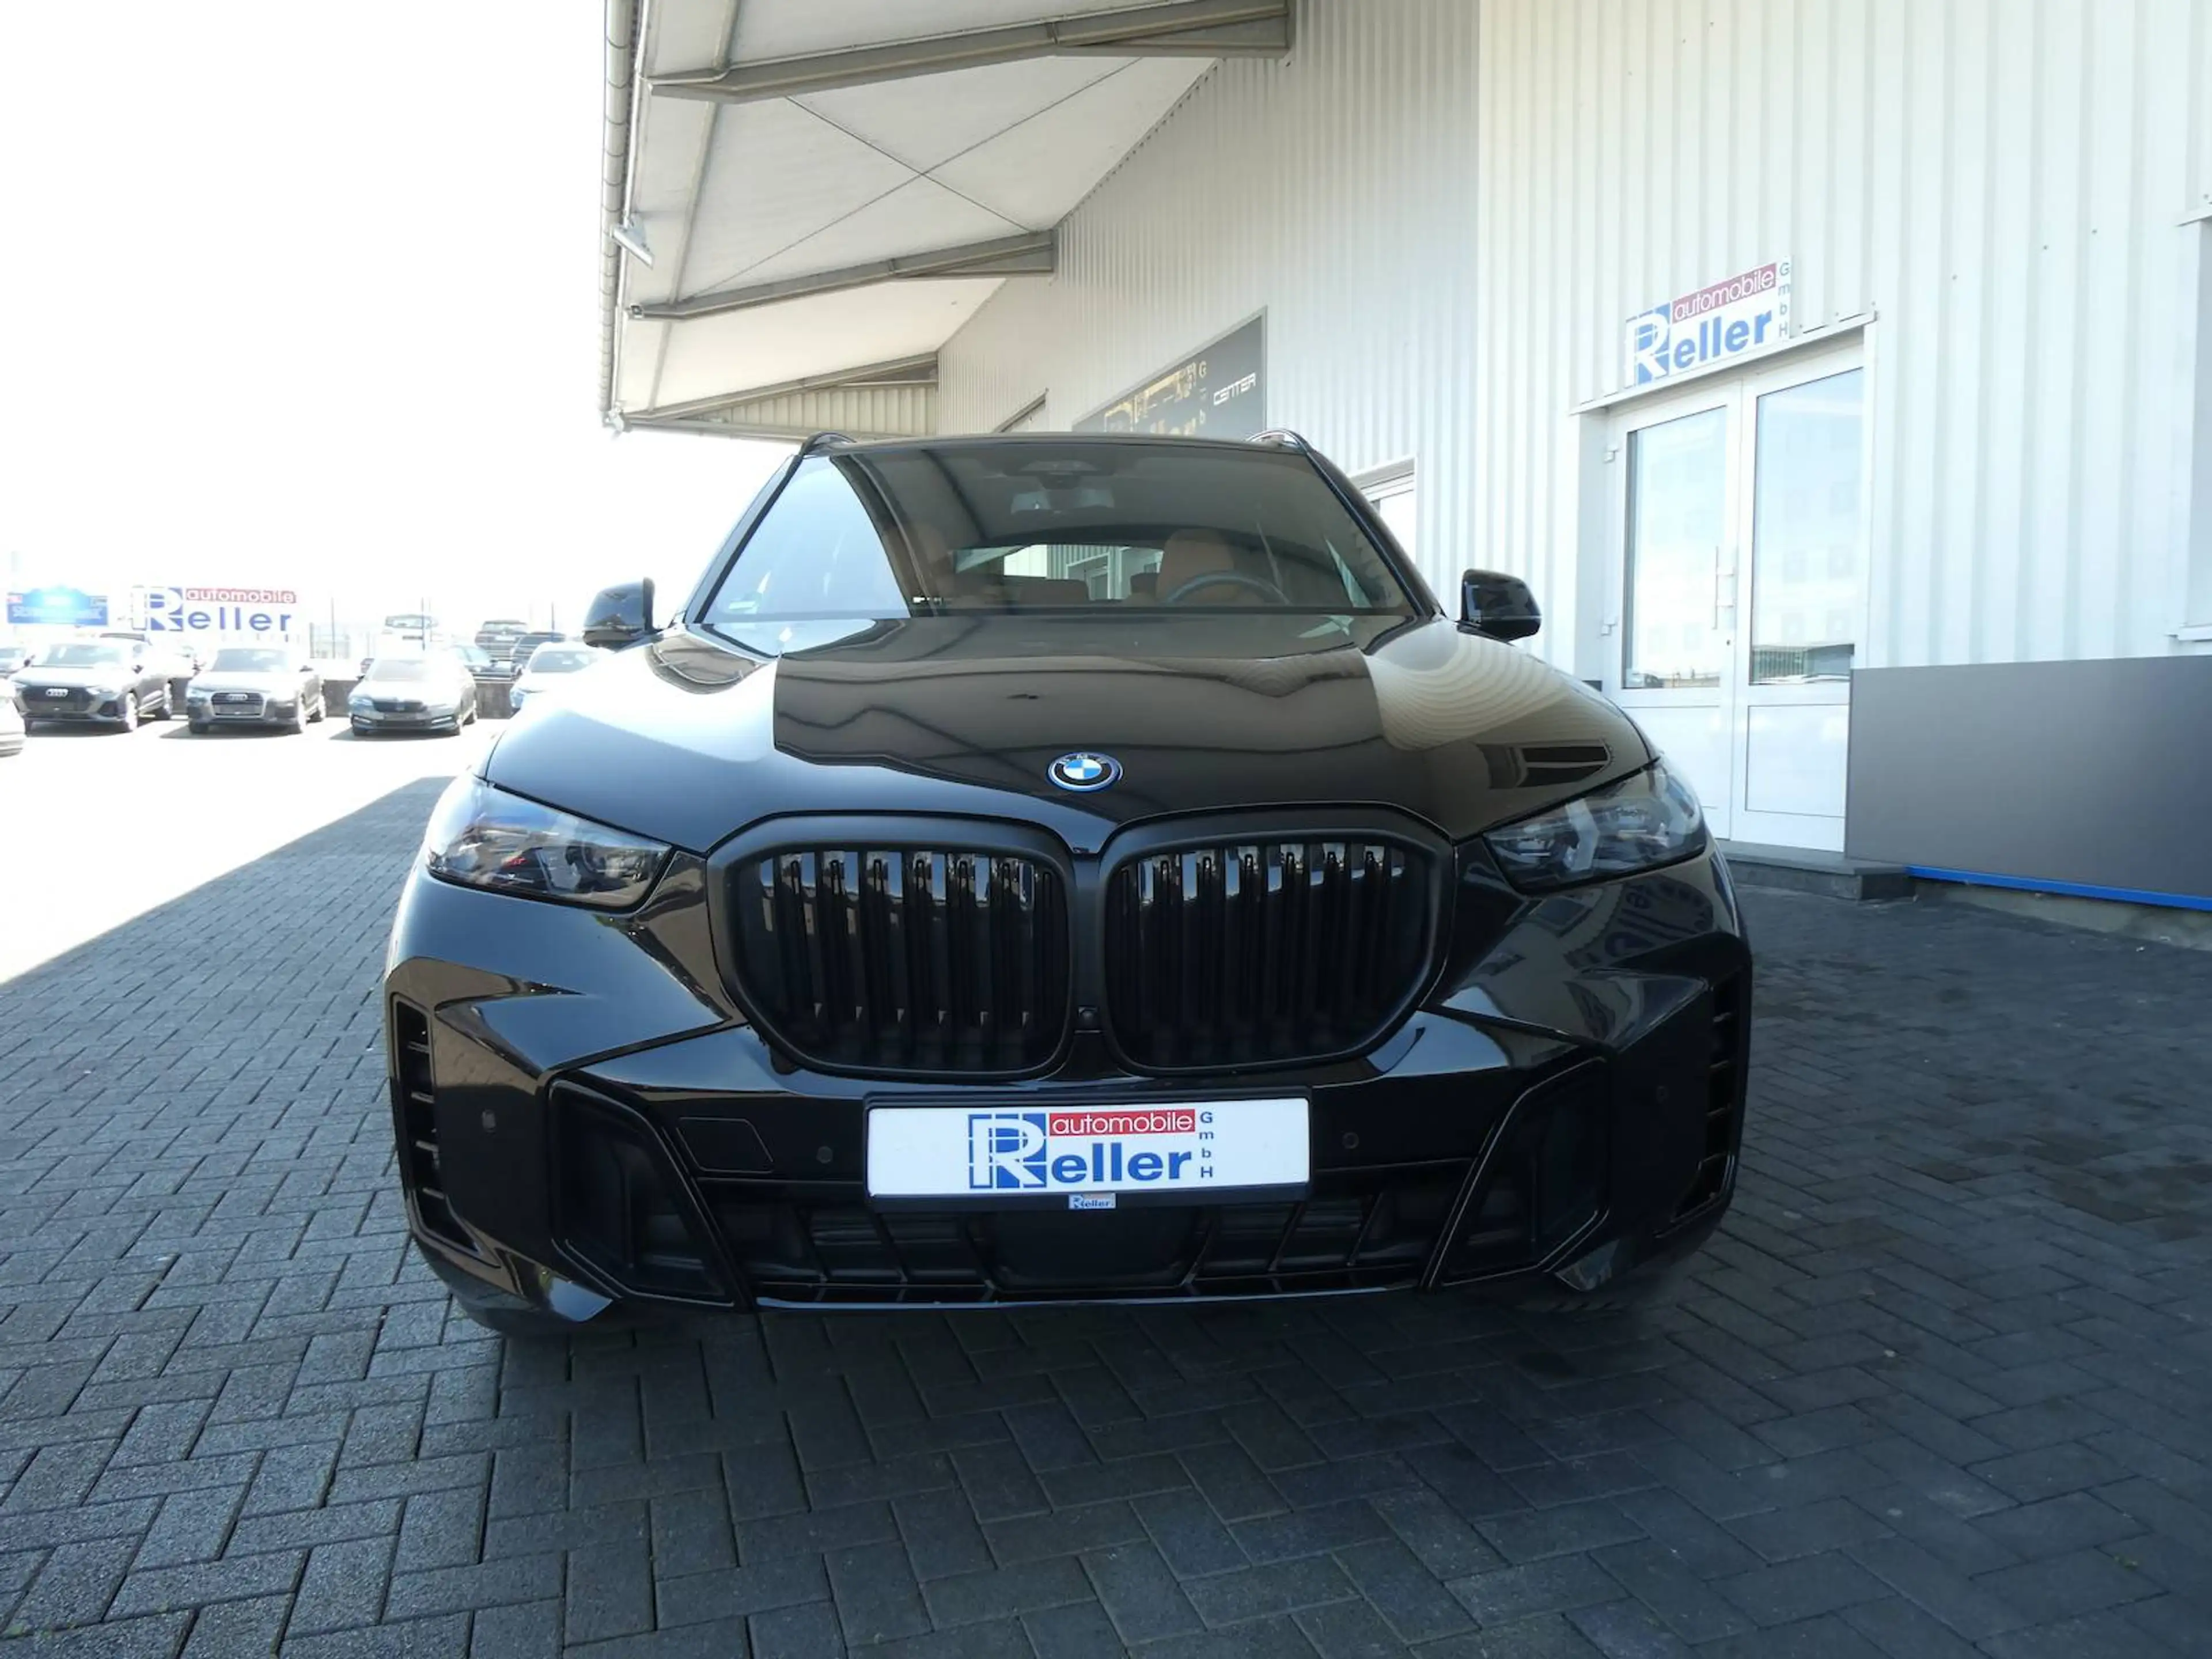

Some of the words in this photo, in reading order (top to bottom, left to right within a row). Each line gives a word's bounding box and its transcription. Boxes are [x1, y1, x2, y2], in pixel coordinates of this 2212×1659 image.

[1673, 269, 1774, 321] automobile
[1624, 304, 1772, 389] Reller
[131, 585, 292, 631] Reller
[186, 589, 294, 603] automobile
[1052, 1112, 1194, 1135] automobile
[1199, 1111, 1214, 1179] GmbH
[968, 1113, 1192, 1189] Reller
